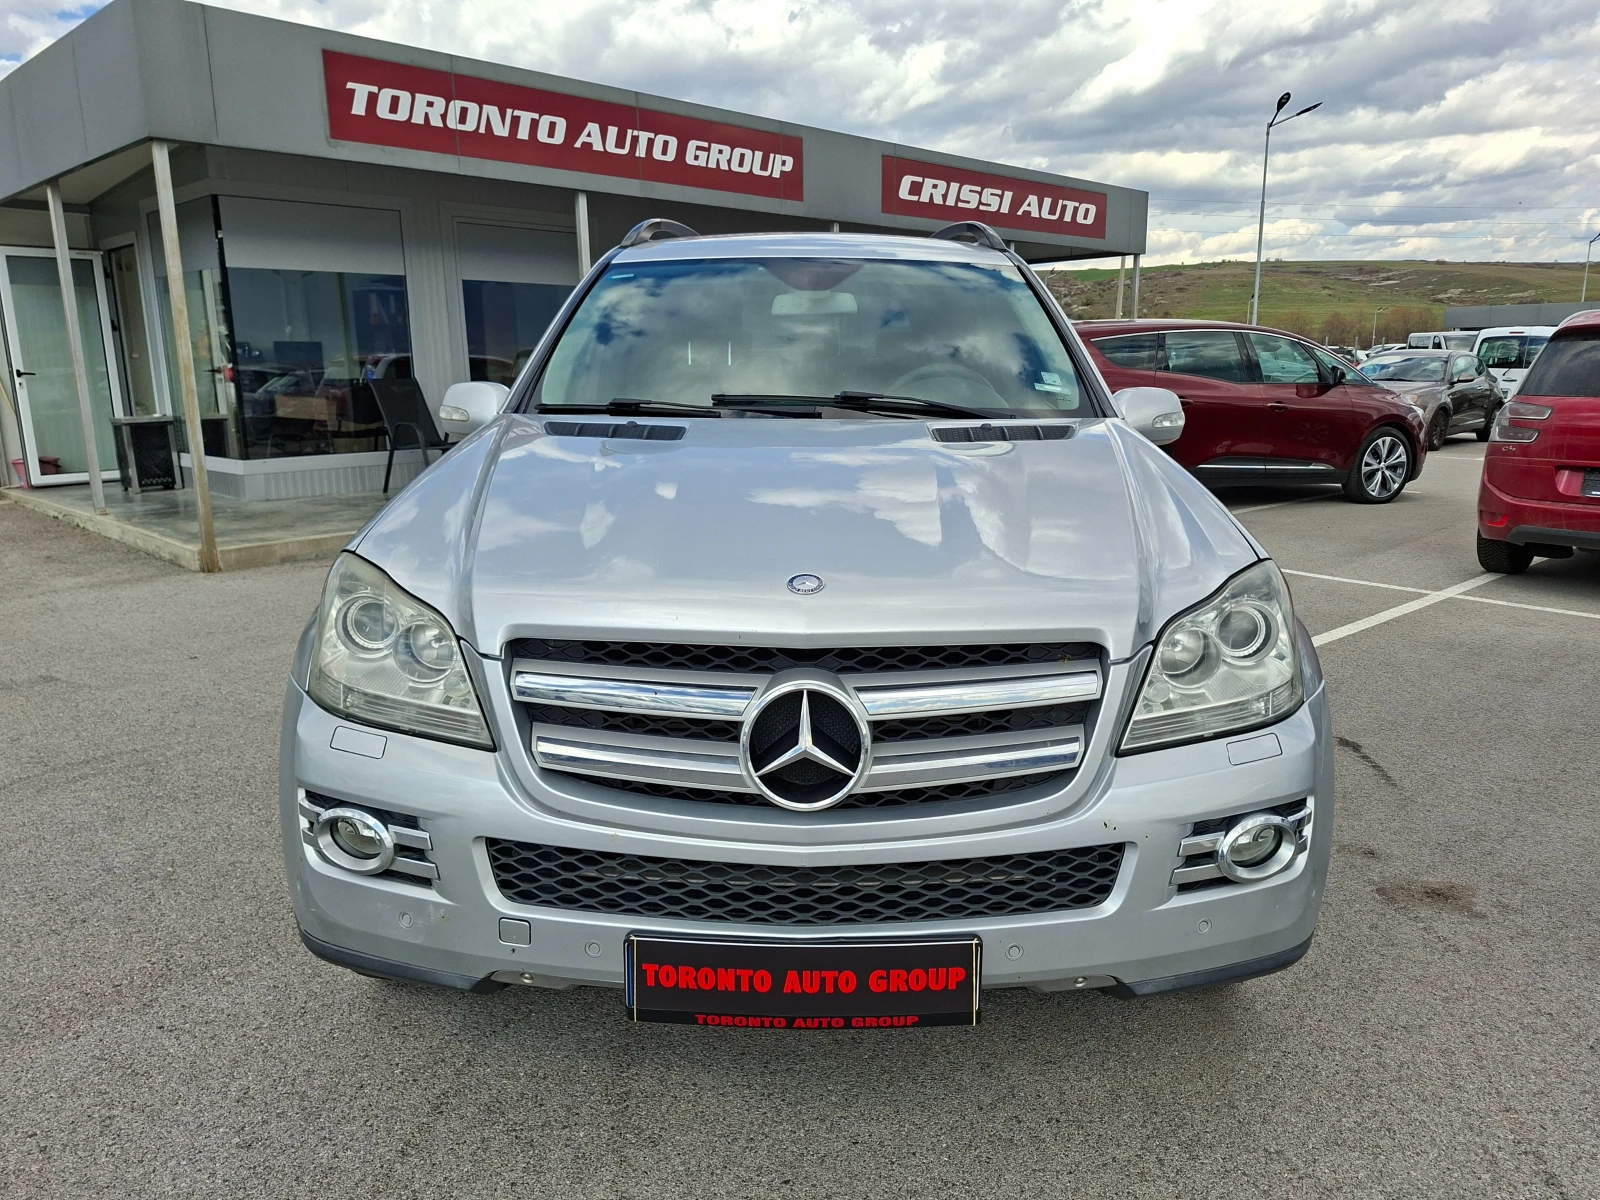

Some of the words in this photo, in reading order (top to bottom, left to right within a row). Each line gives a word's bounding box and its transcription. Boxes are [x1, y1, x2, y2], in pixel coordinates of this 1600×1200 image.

[345, 81, 567, 145] TORONTO
[573, 122, 679, 163] AUTO
[685, 139, 794, 179] GROUP
[898, 174, 1014, 214] CRISSI
[1016, 194, 1097, 225] AUTO
[642, 963, 773, 993] TORONTO
[783, 970, 857, 994] AUTO
[868, 967, 967, 993] GROUP
[694, 1014, 787, 1029] TORONTO
[792, 1016, 845, 1029] AUTO
[851, 1015, 920, 1028] GROUP
